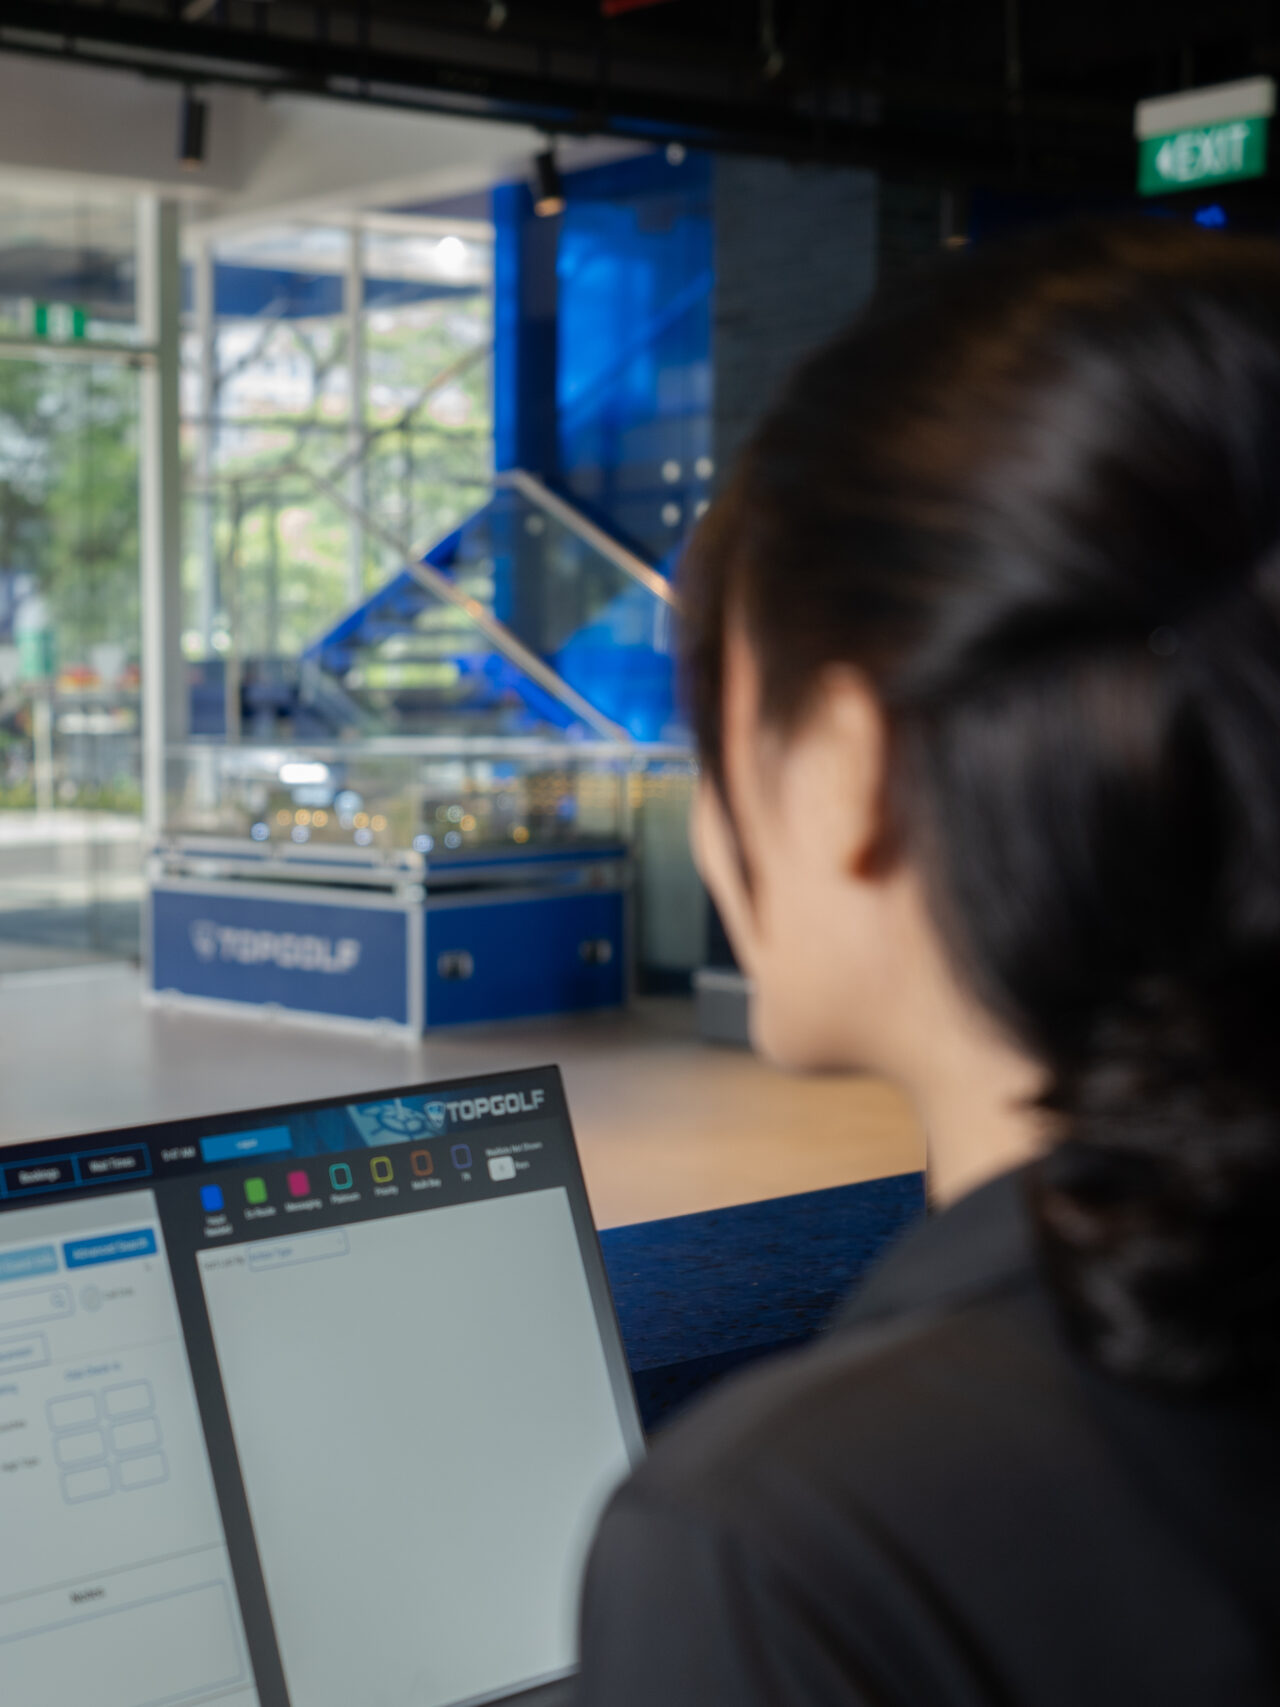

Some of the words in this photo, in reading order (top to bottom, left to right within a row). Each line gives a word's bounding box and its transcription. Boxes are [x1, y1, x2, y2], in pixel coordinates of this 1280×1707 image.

[1173, 122, 1250, 182] EXIT
[216, 926, 361, 973] TOPGOLF
[446, 1089, 545, 1122] TOPGOLF
[70, 1585, 105, 1604] Notes
